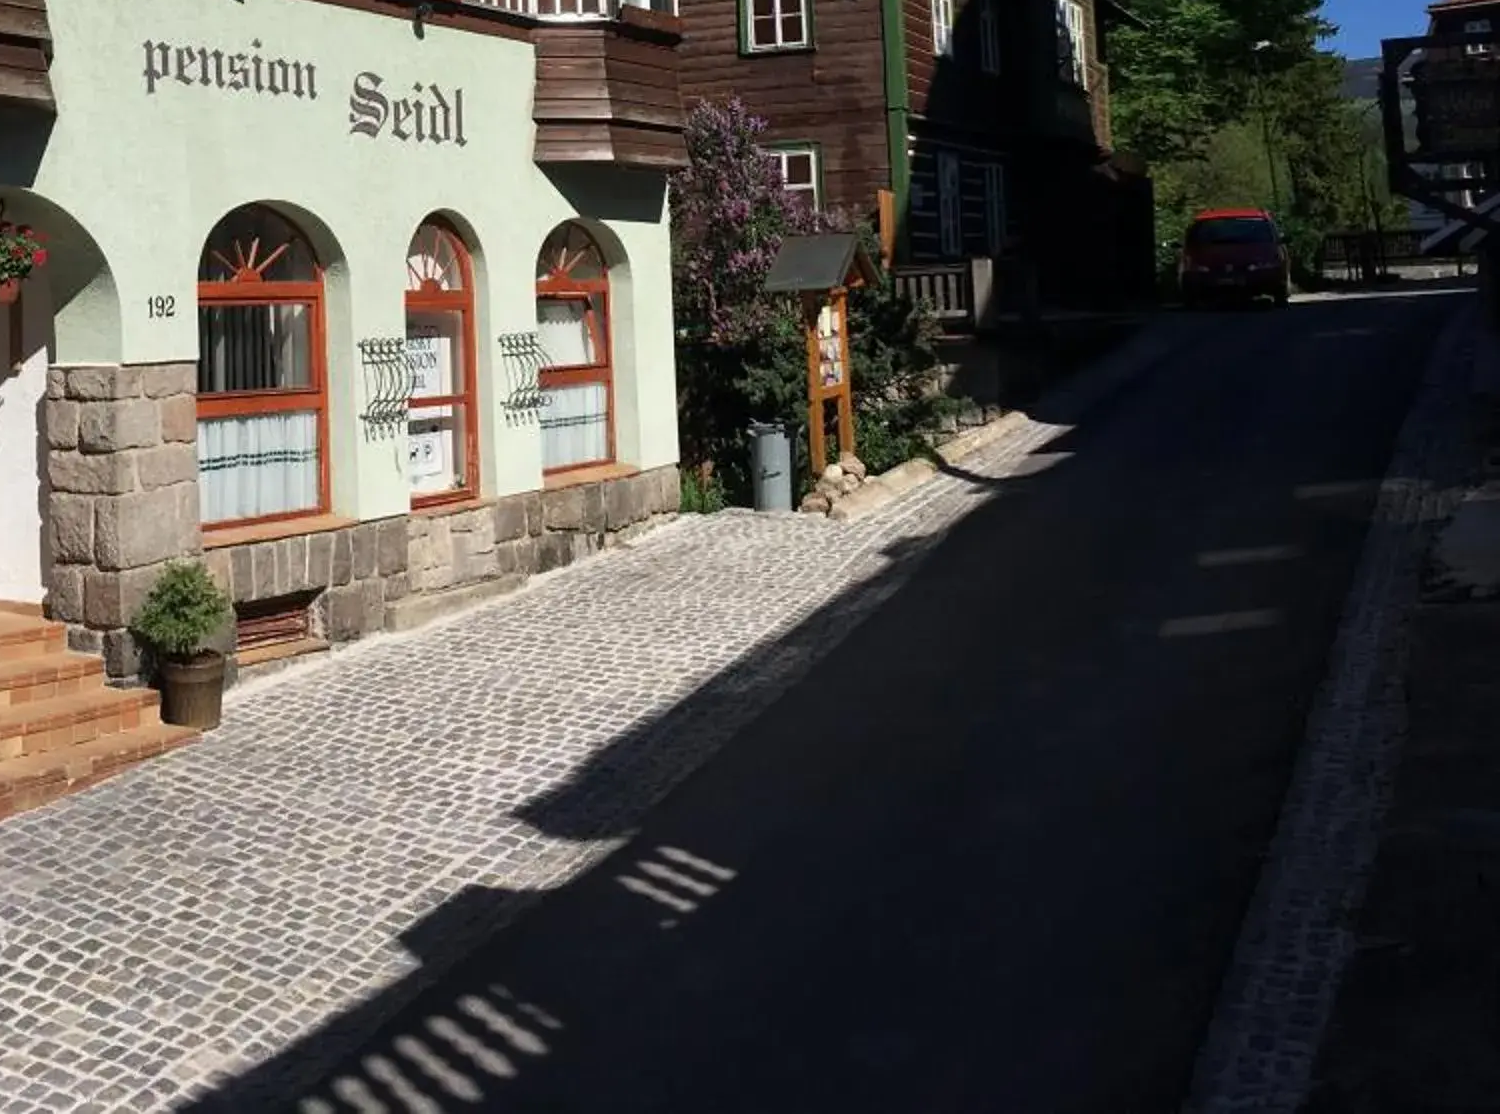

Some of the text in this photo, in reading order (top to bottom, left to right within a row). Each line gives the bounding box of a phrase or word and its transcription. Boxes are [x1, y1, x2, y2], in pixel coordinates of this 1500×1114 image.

[142, 38, 468, 147] pension Seidl
[148, 295, 175, 318] 192
